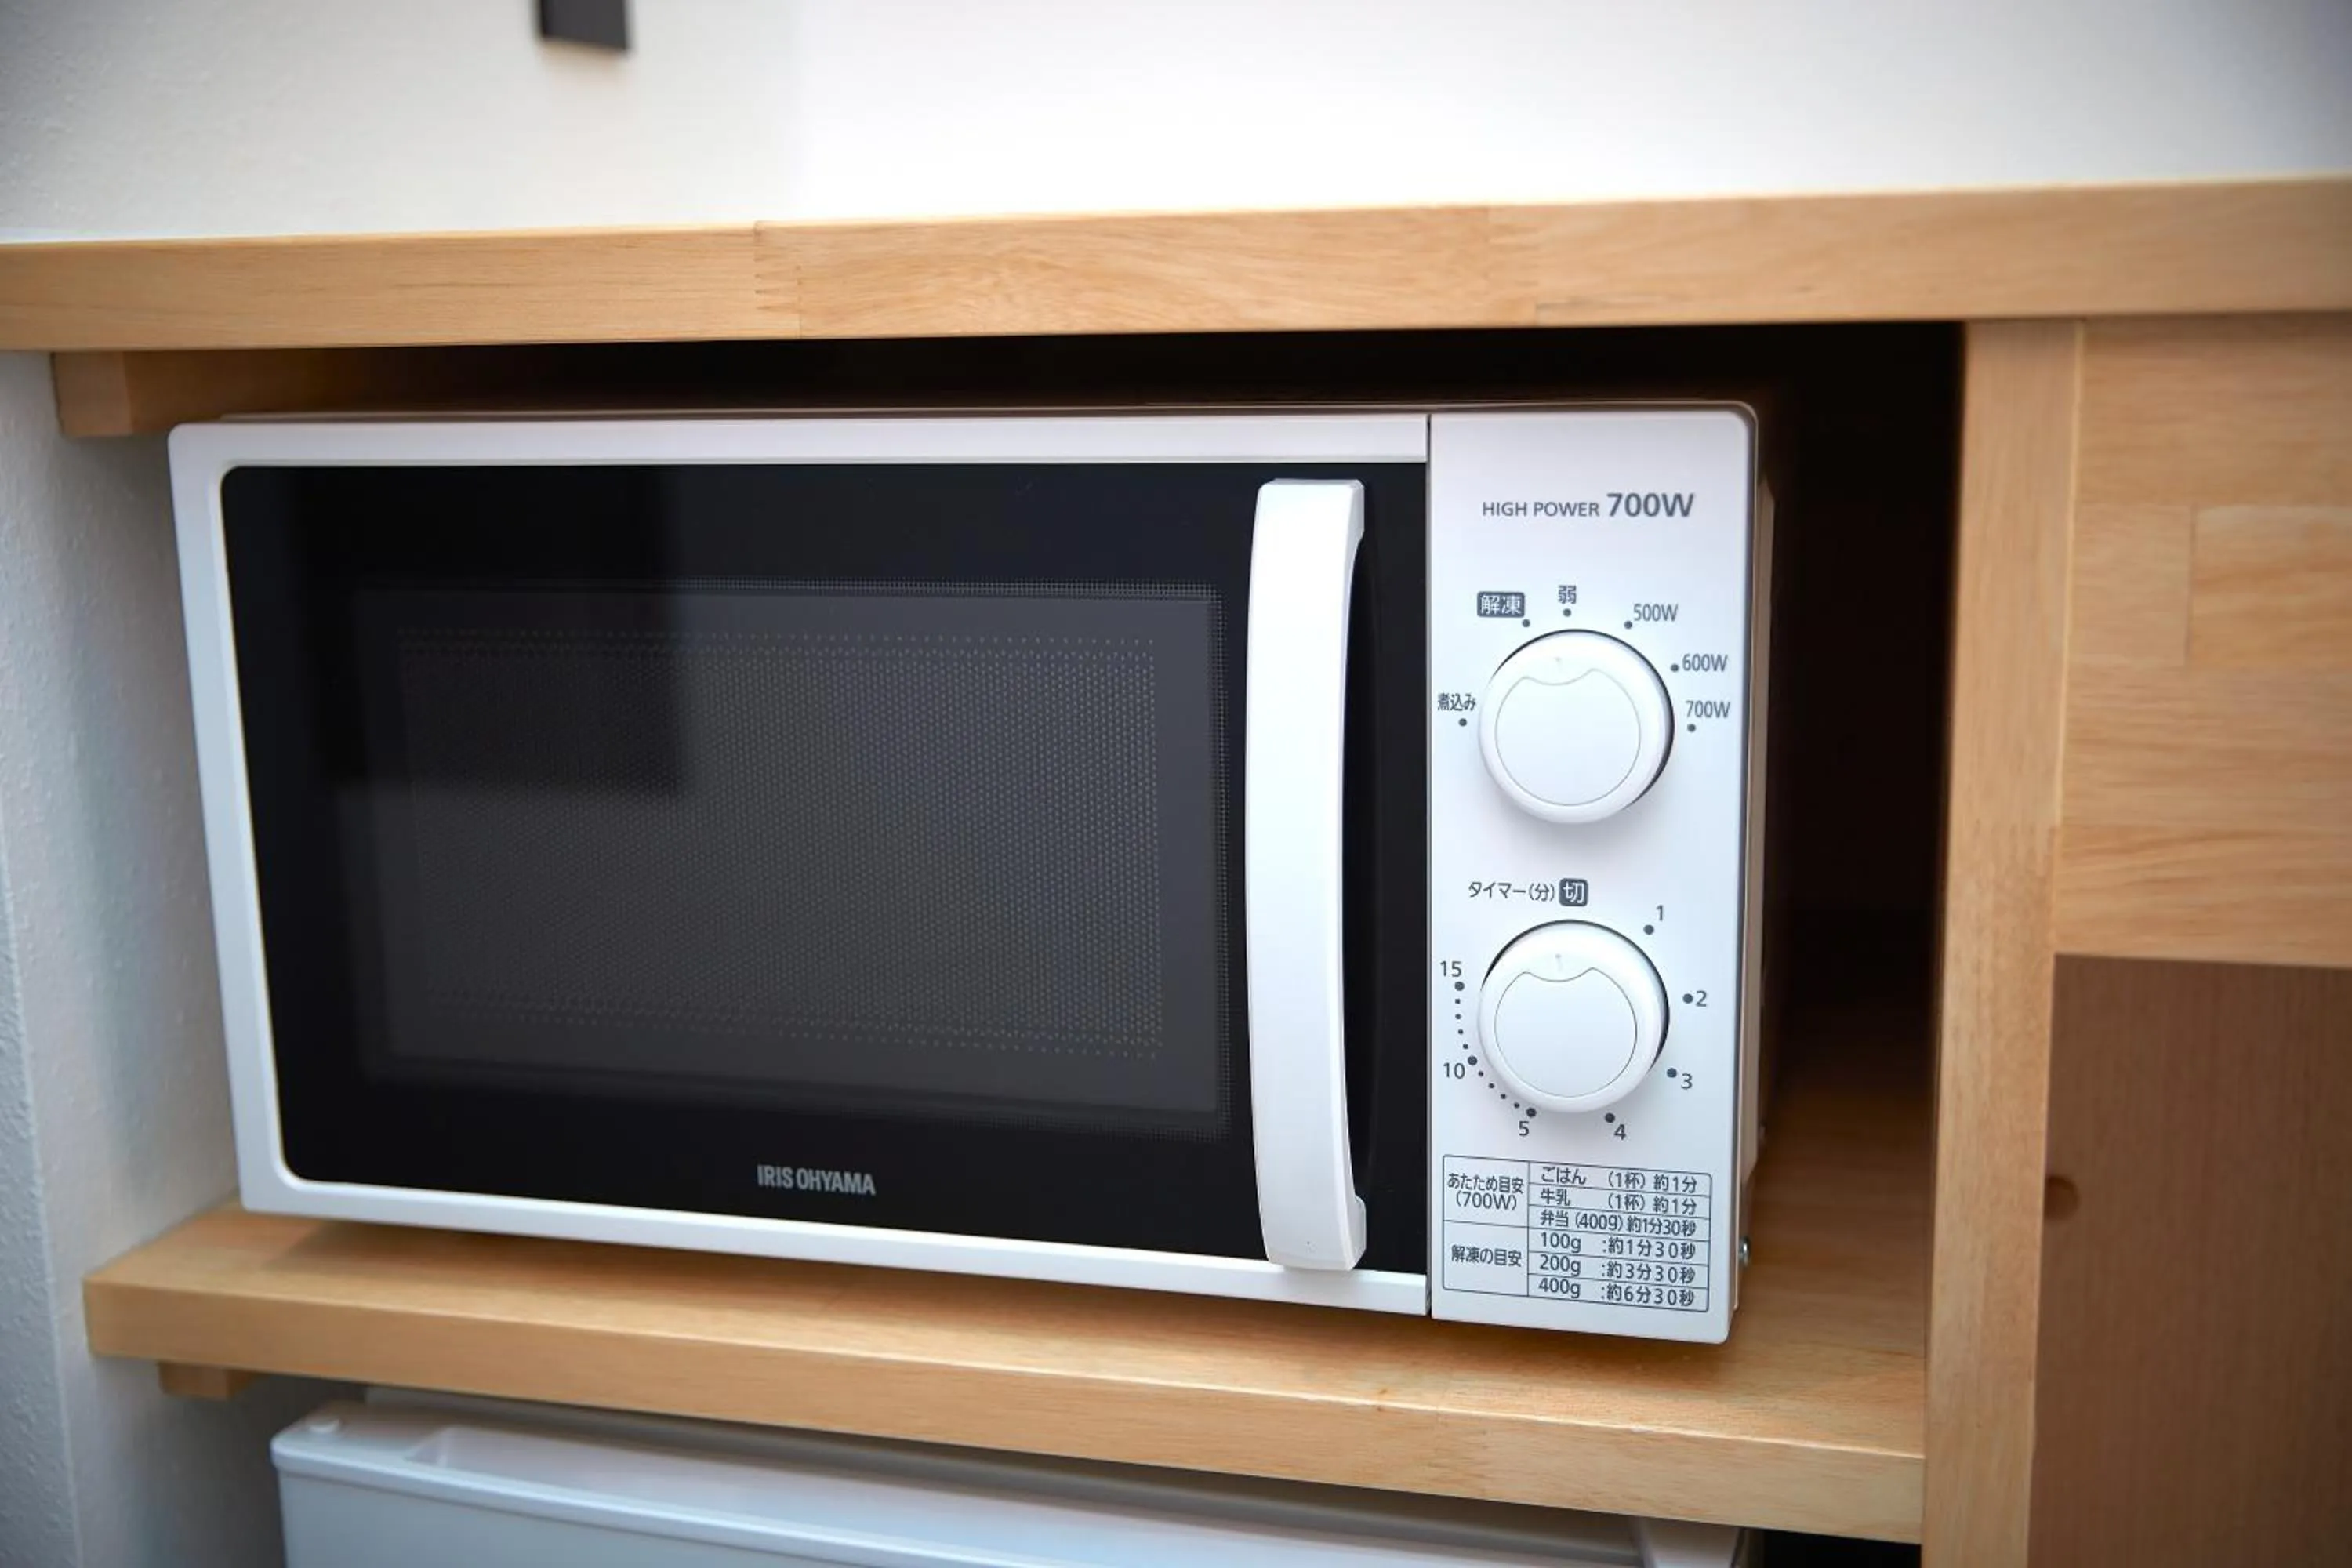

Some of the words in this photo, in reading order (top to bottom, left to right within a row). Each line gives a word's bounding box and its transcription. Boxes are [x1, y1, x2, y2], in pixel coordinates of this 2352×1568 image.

[1482, 501, 1528, 517] HIGH
[1533, 502, 1599, 517] POWER
[1607, 493, 1694, 517] 700W
[1559, 585, 1577, 604] 弱
[1480, 594, 1522, 615] 解凍
[1633, 604, 1678, 622] 500W
[1682, 654, 1728, 672] 600W
[1437, 693, 1476, 711] 煮込み
[1686, 701, 1730, 719] 700W
[1563, 883, 1584, 902] 切
[1657, 906, 1664, 921] 1
[1440, 961, 1462, 977] 15
[1696, 991, 1708, 1007] 2
[1443, 1063, 1465, 1079] 10
[1681, 1073, 1693, 1089] 3
[1519, 1121, 1530, 1137] 5
[1614, 1124, 1627, 1140] 4
[757, 1165, 793, 1189] IRIS
[796, 1168, 876, 1196] OHYAMA
[1447, 1173, 1524, 1195] あたため目安
[1541, 1166, 1586, 1185] ごはん
[1456, 1190, 1518, 1212] (700W)
[1540, 1189, 1570, 1207] 牛乳
[1540, 1210, 1569, 1229] 弁当
[1541, 1232, 1582, 1254] 100g
[1451, 1245, 1522, 1268] 解凍の目安
[1540, 1254, 1581, 1277] 200g
[1538, 1278, 1581, 1299] 400g
